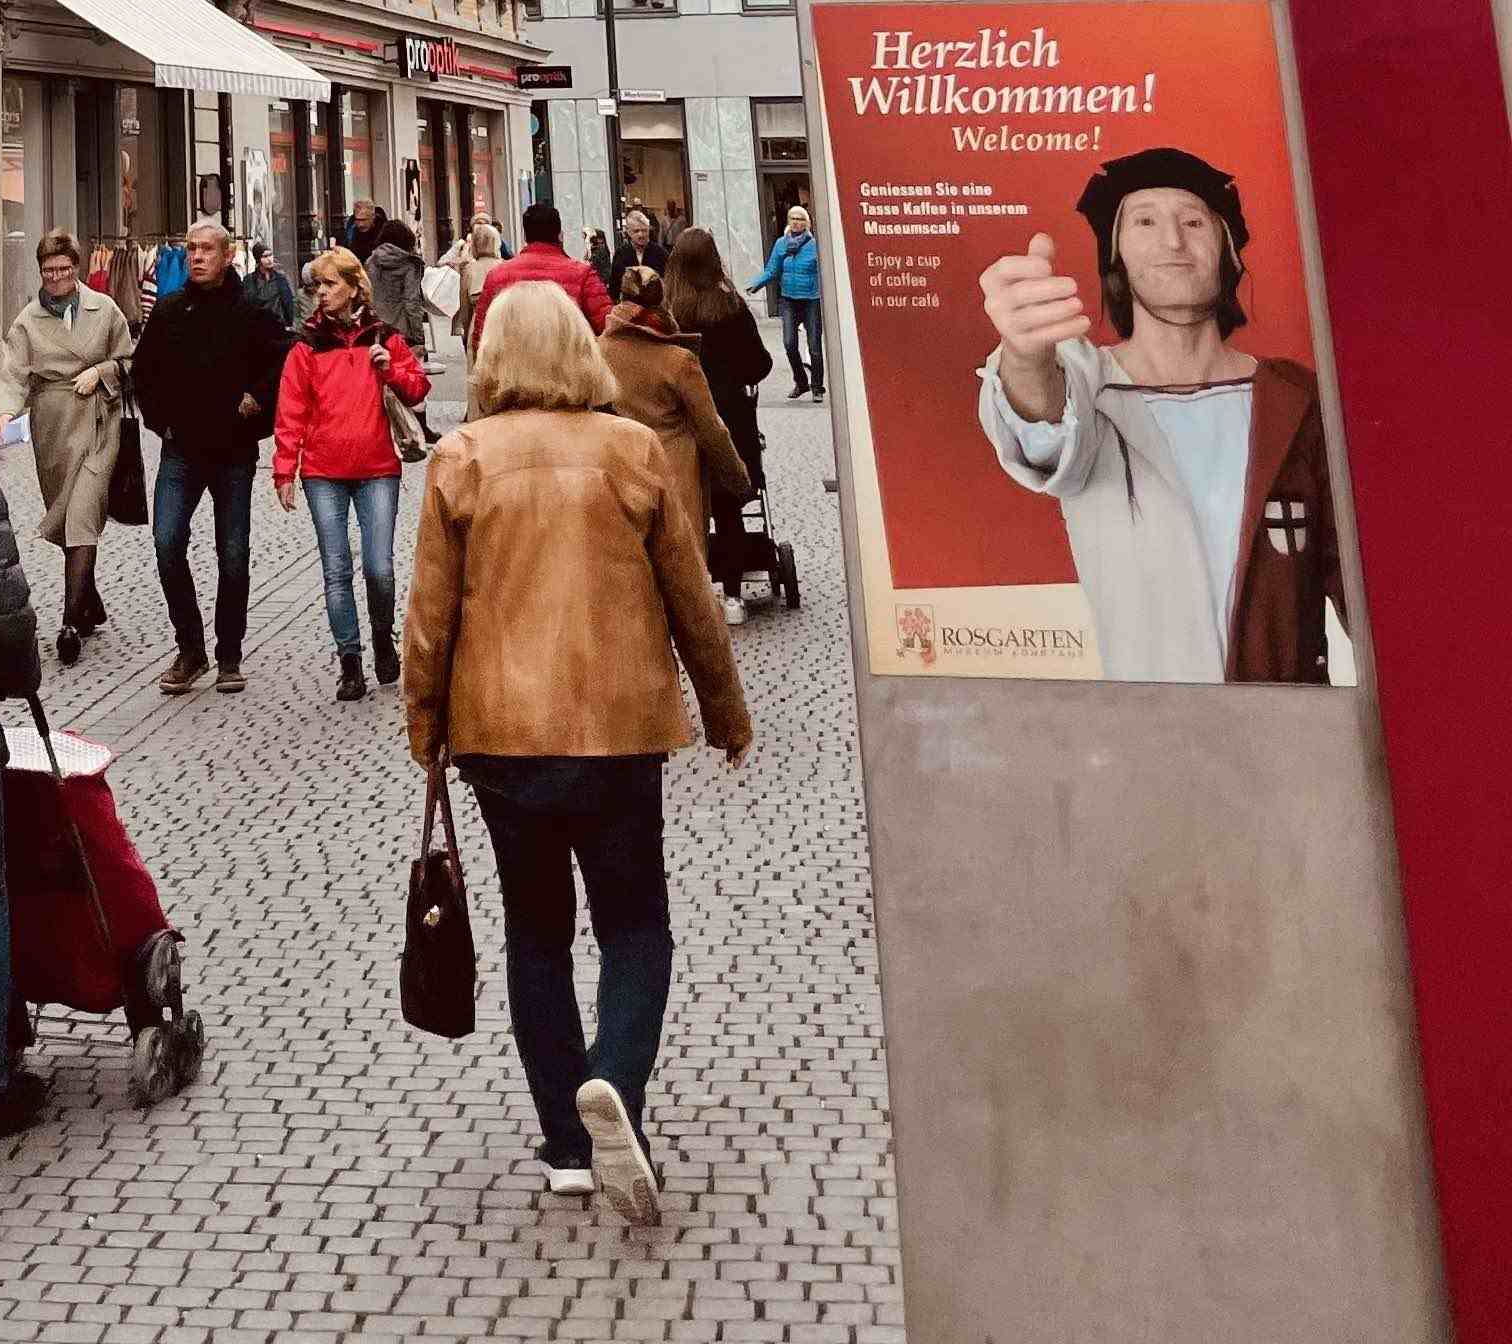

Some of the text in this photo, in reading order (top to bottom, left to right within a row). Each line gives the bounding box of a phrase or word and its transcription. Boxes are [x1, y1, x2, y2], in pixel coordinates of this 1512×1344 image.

[871, 27, 1060, 69] Herzlich
[847, 73, 1157, 115] Willkommen!
[952, 125, 1102, 151] Welcome!
[860, 183, 993, 197] Geniessen Sie eine
[860, 202, 1028, 216] Tasse Kaffee in unserem
[864, 220, 960, 235] Museumscafé
[867, 252, 941, 270] Enjoy a cup
[870, 273, 927, 287] of coffee
[871, 293, 940, 307] in our café
[941, 627, 1087, 648] ROSGARTEN
